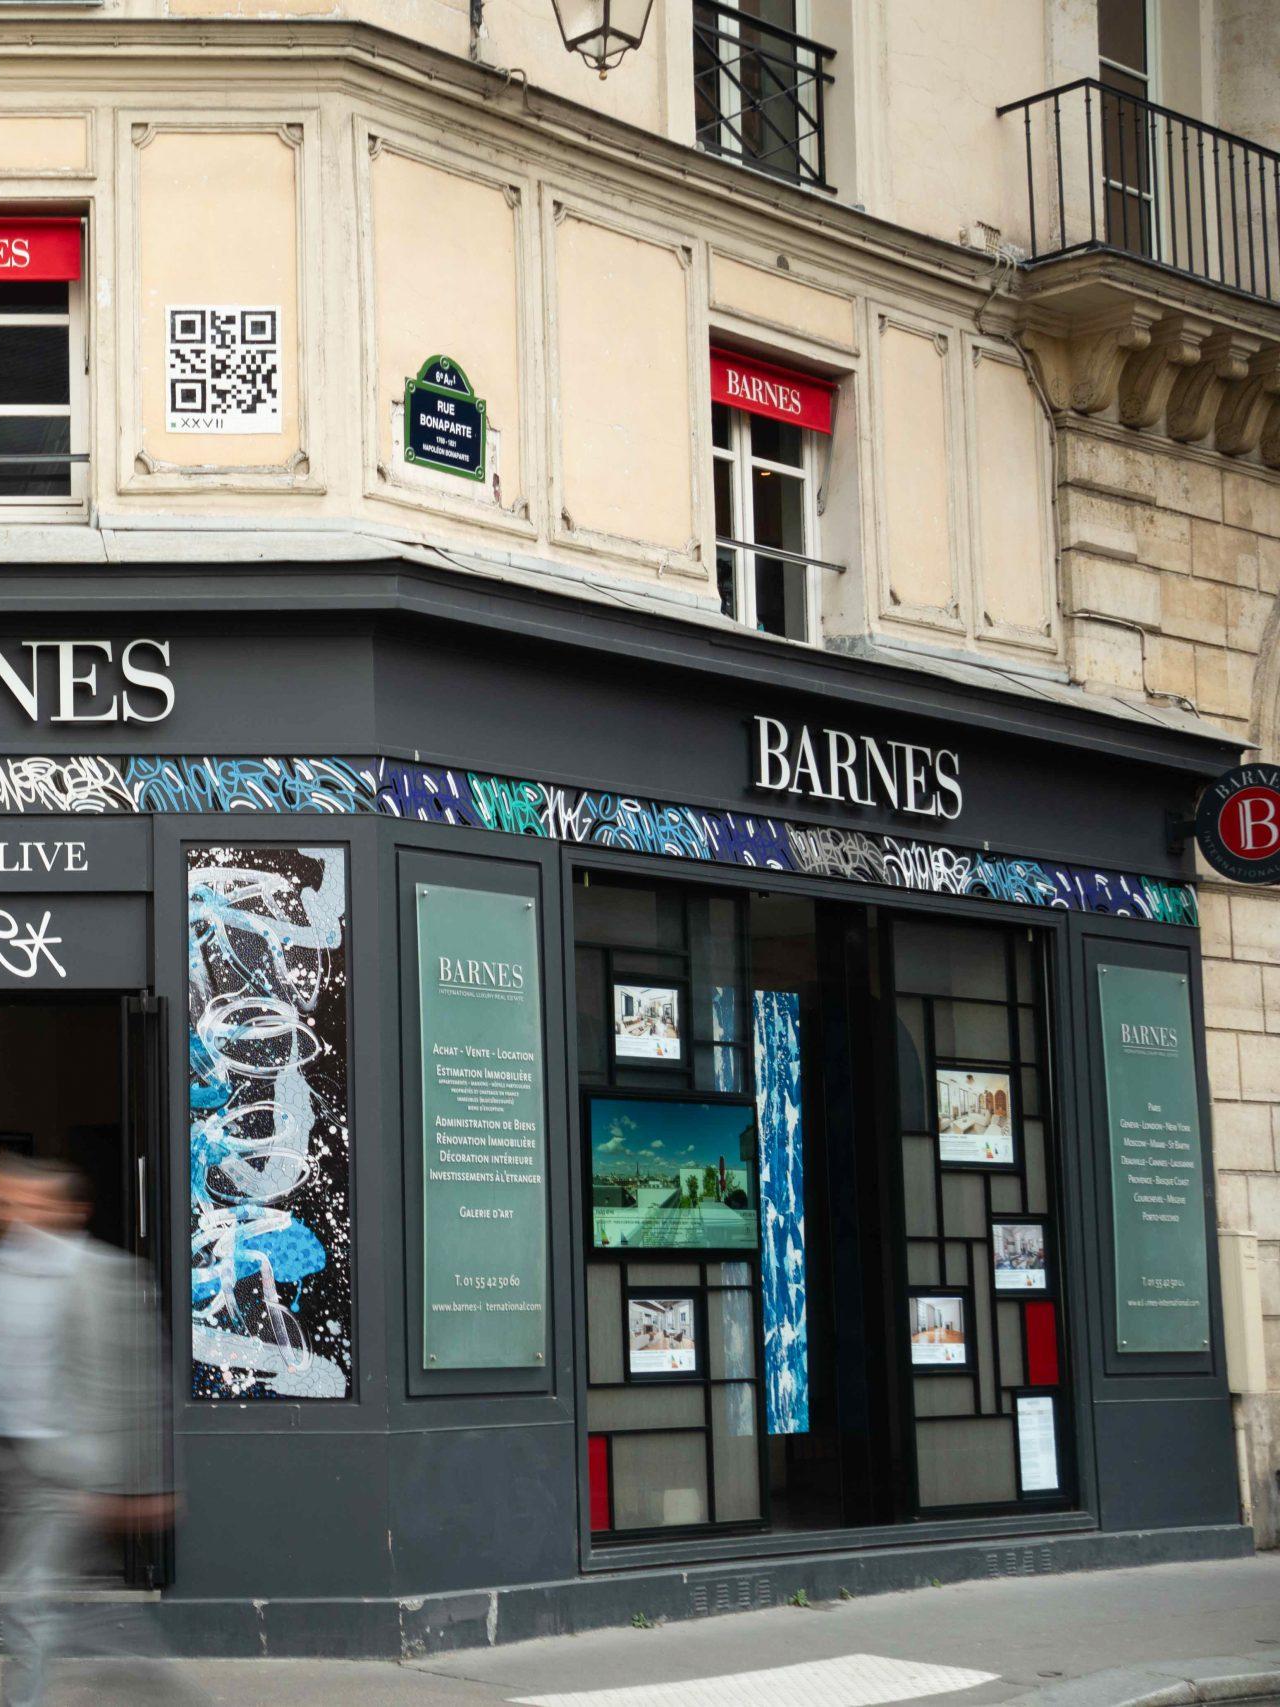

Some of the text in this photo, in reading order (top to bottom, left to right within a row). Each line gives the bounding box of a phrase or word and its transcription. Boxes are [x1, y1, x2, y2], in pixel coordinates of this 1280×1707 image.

[726, 368, 801, 415] BARNES
[437, 400, 455, 416] RUE
[181, 418, 223, 429] XXVII
[420, 413, 472, 438] BONAPARTE
[445, 449, 470, 462] BONAPARTE
[753, 715, 963, 820] BARNES
[1215, 769, 1280, 799] BARNE
[439, 956, 523, 988] BARNES
[1121, 1023, 1178, 1047] BARNES
[463, 1277, 473, 1286] 01
[475, 1277, 485, 1289] 55
[486, 1278, 496, 1288] 42
[499, 1277, 508, 1289] 50
[510, 1274, 520, 1286] 60
[432, 1301, 542, 1312] www.barnes-iternational.com
